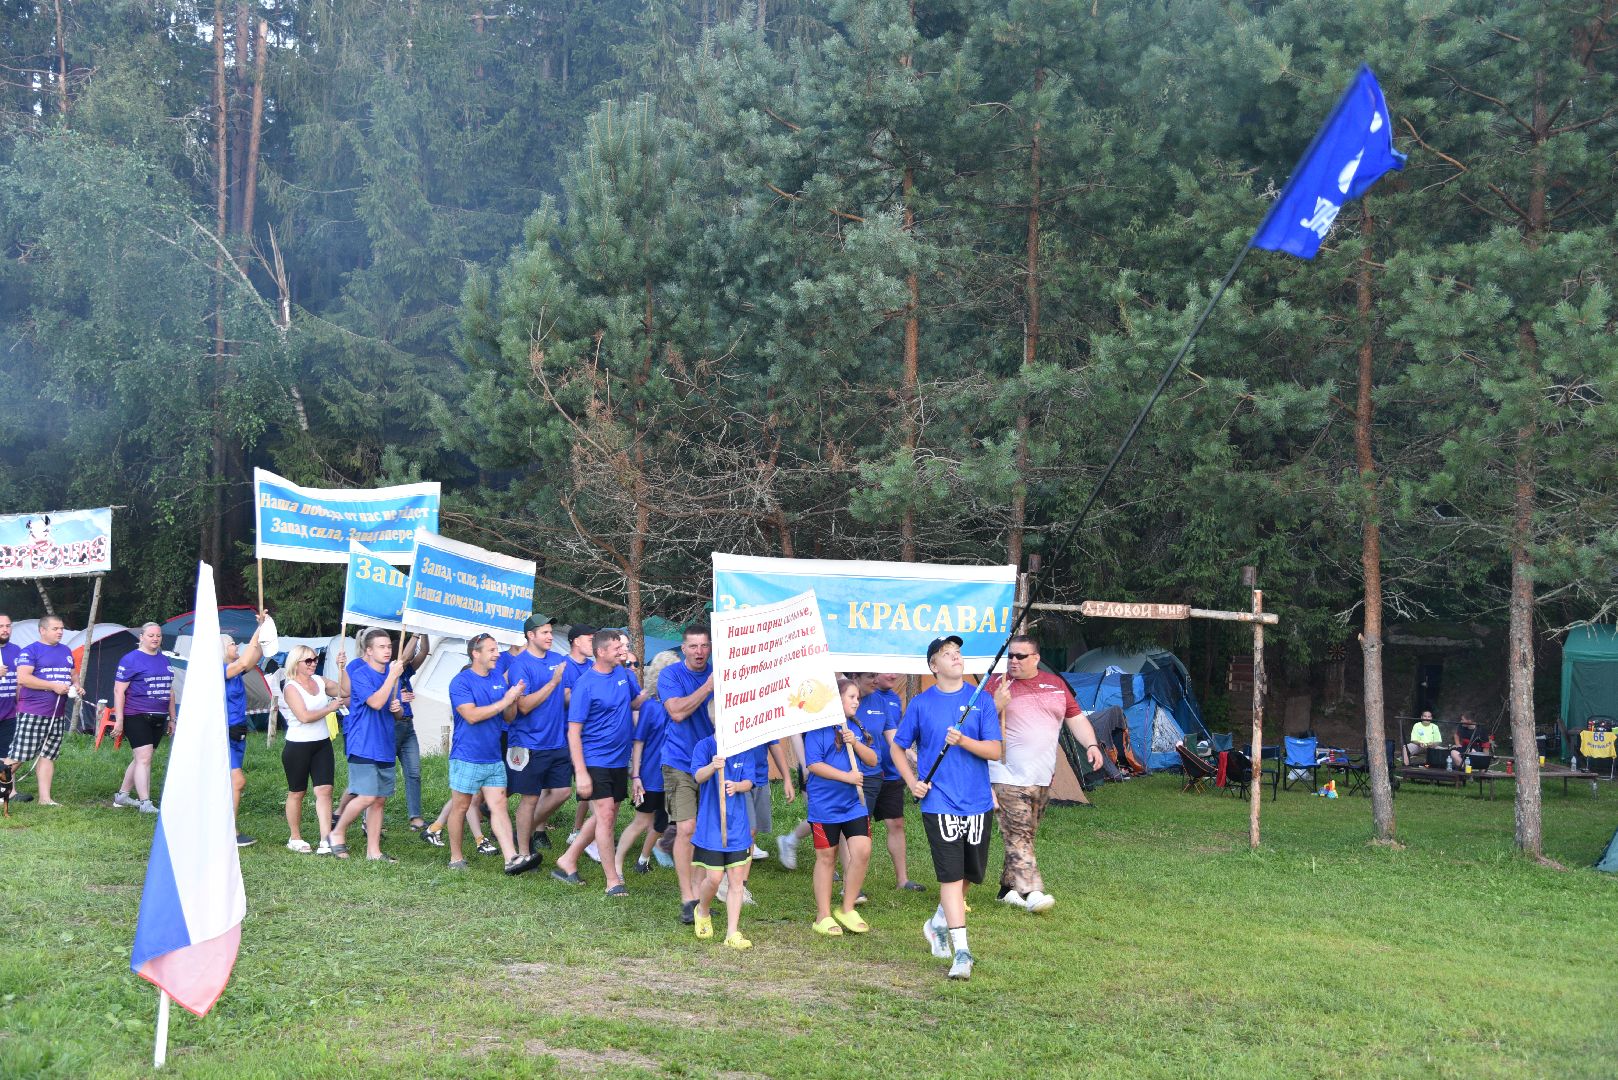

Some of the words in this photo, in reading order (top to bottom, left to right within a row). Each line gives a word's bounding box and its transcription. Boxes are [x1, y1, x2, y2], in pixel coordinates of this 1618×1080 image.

[260, 493, 299, 512] Наша
[300, 503, 343, 521] победа
[344, 512, 358, 521] от
[359, 511, 382, 522] нас
[383, 510, 397, 521] не
[271, 517, 309, 539] Запад
[310, 526, 344, 542] сила,
[378, 529, 414, 543] впере
[421, 557, 452, 583] Запад
[457, 571, 479, 590] сила,
[413, 581, 442, 603] Наша
[444, 592, 483, 614] команда
[485, 602, 515, 619] лучше
[1084, 602, 1152, 618] ДЕЛОВОЙ
[727, 625, 755, 639] Наши
[756, 617, 783, 633] парни
[847, 601, 1009, 633] КРАСАВА!
[729, 643, 757, 659] Наши
[758, 637, 784, 652] парни
[723, 669, 730, 681] И
[738, 661, 773, 680] футбол
[725, 686, 756, 709] Наши
[758, 677, 790, 698] ваших
[734, 705, 785, 733] сделают
[1593, 732, 1605, 742] 66
